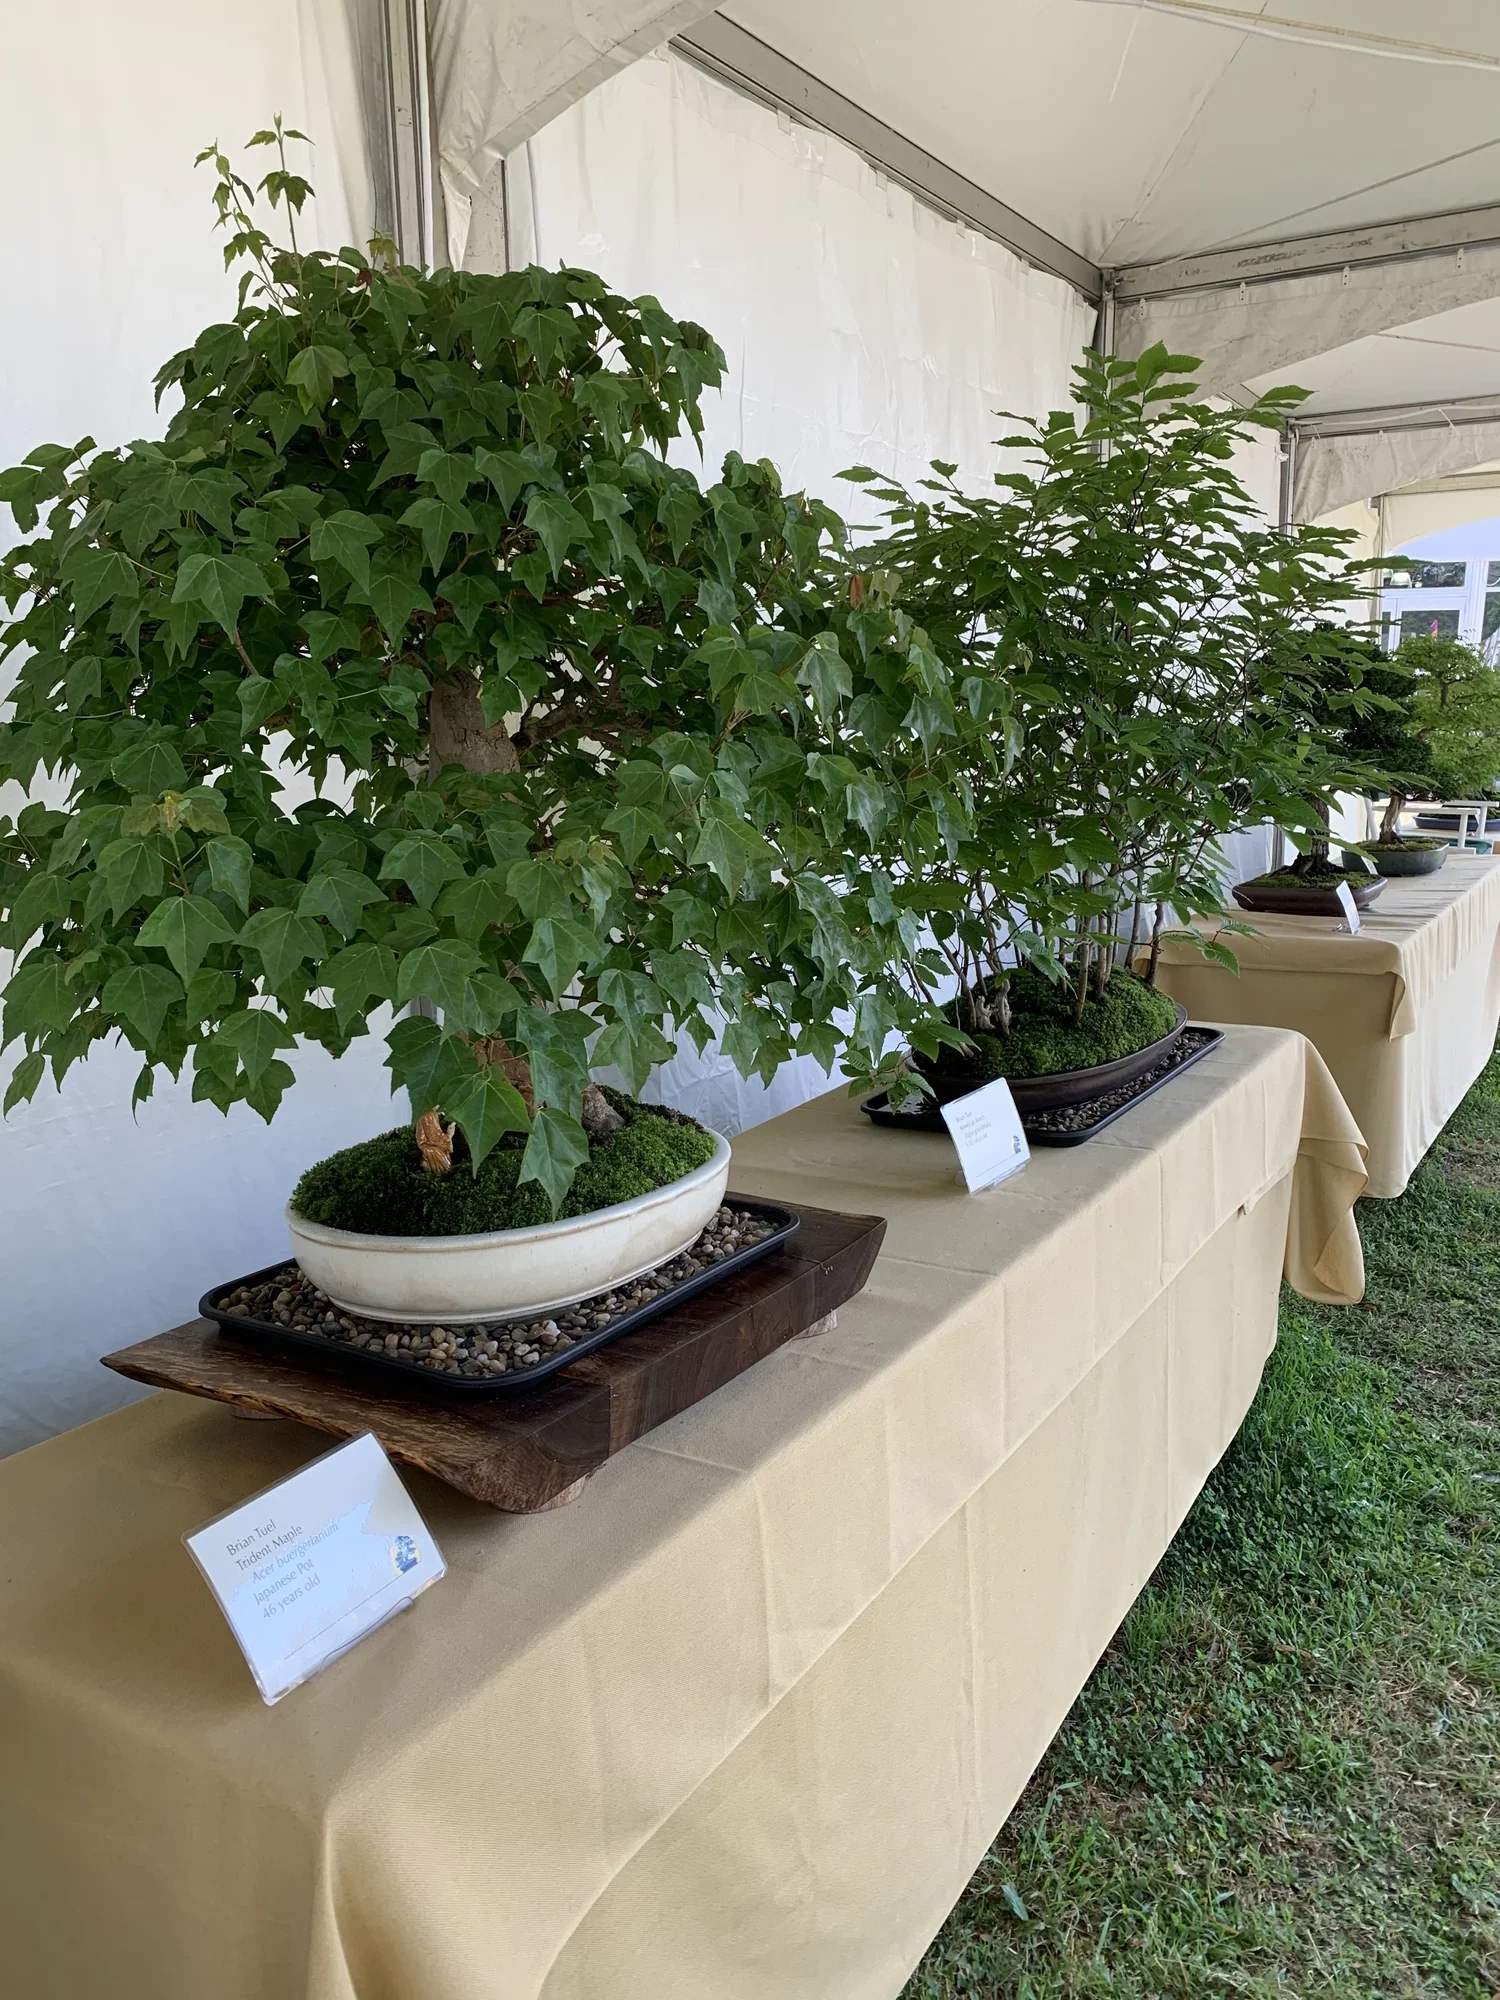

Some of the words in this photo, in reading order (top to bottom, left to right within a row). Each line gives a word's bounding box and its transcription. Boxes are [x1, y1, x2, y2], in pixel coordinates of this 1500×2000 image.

[226, 1535, 256, 1556] Brian
[253, 1519, 277, 1538] Tuel
[234, 1543, 272, 1571] Trident
[271, 1525, 304, 1550] Maple
[252, 1563, 275, 1584] Acer
[275, 1522, 339, 1568] buergerianum
[253, 1570, 297, 1606] Japanese
[296, 1558, 315, 1575] Pot
[263, 1603, 277, 1619] 46
[278, 1588, 304, 1613] years
[304, 1572, 321, 1591] old
